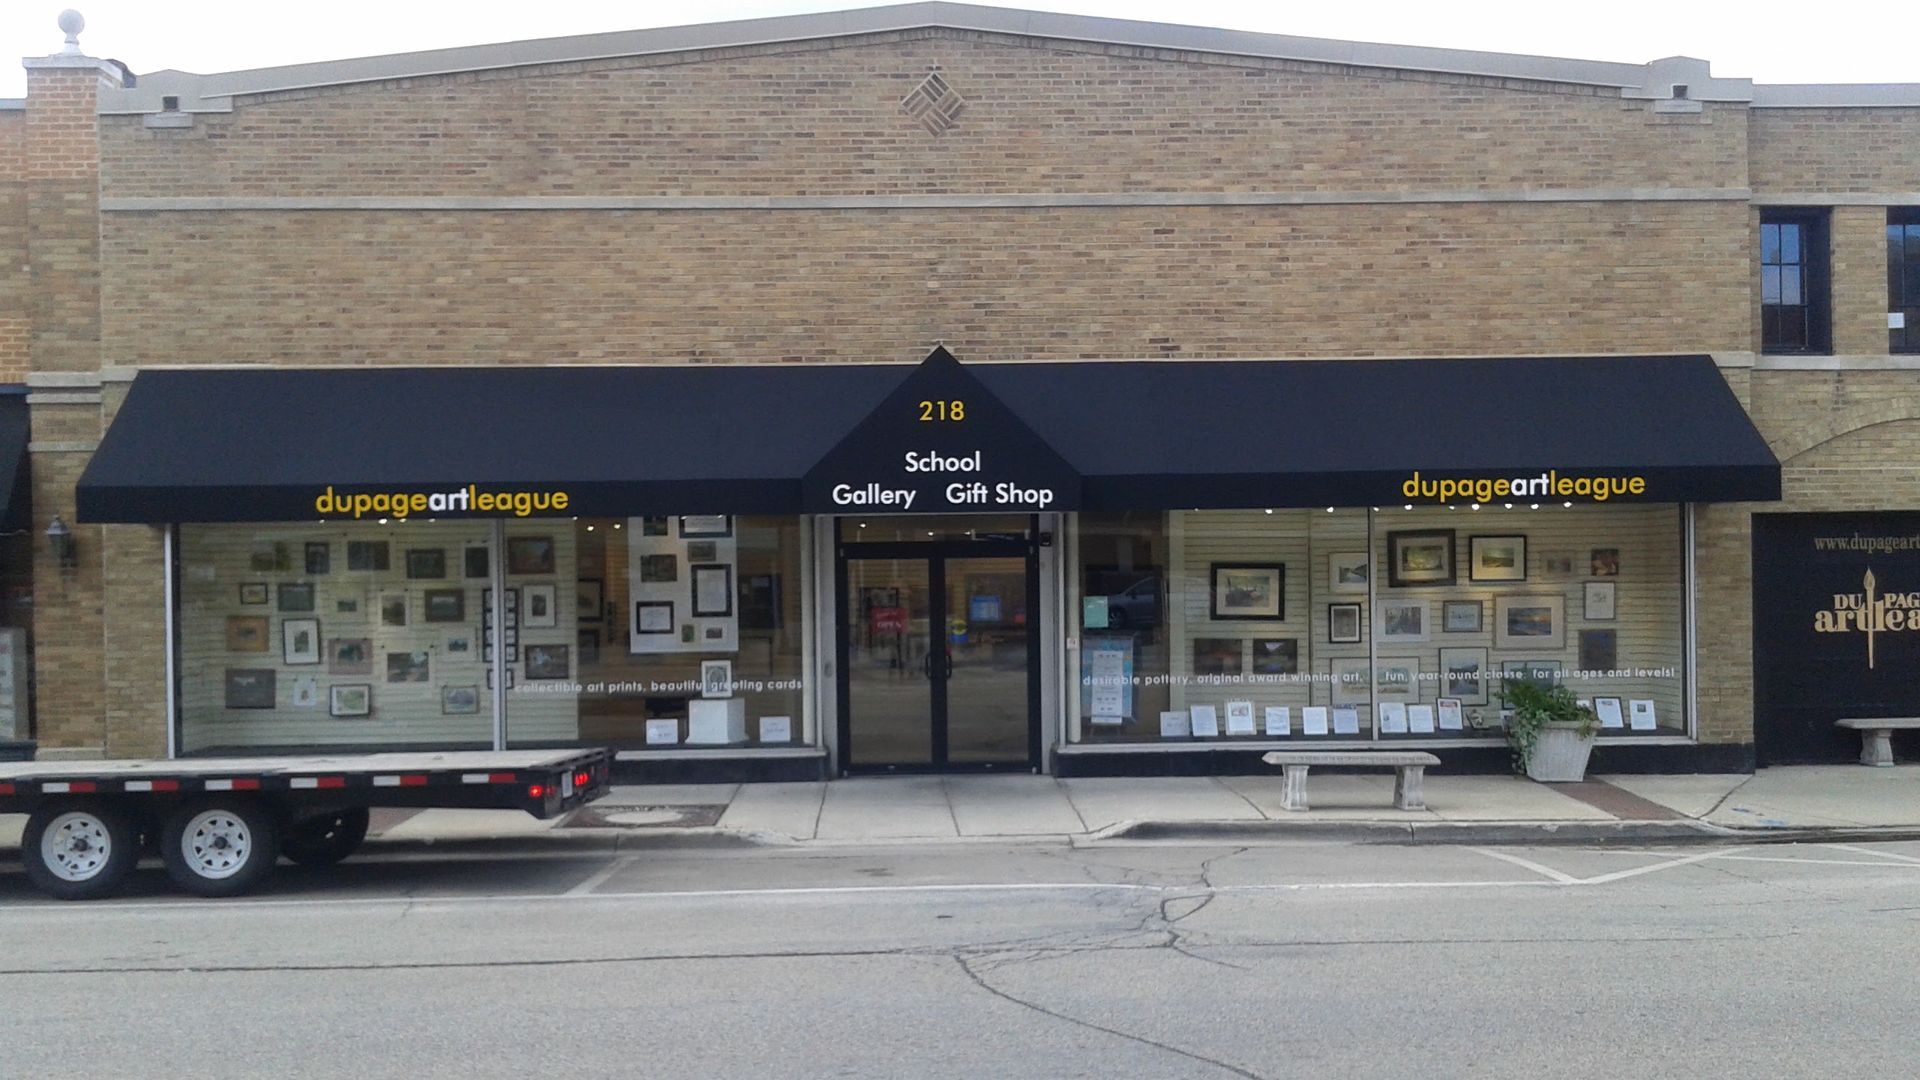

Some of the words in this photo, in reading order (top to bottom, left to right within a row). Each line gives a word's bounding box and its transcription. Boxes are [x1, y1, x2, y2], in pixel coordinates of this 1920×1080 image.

[919, 400, 965, 421] 218
[904, 451, 981, 472] School
[832, 483, 916, 510] Gallery
[945, 482, 988, 504] Gift
[995, 481, 1053, 509] Shop
[1402, 469, 1646, 503] dupageartleague
[315, 484, 569, 519] dupageartleague
[1248, 673, 1287, 684] award
[1290, 671, 1339, 684] winning
[1606, 668, 1632, 679] and
[587, 681, 605, 692] art
[651, 679, 703, 692] beautifu
